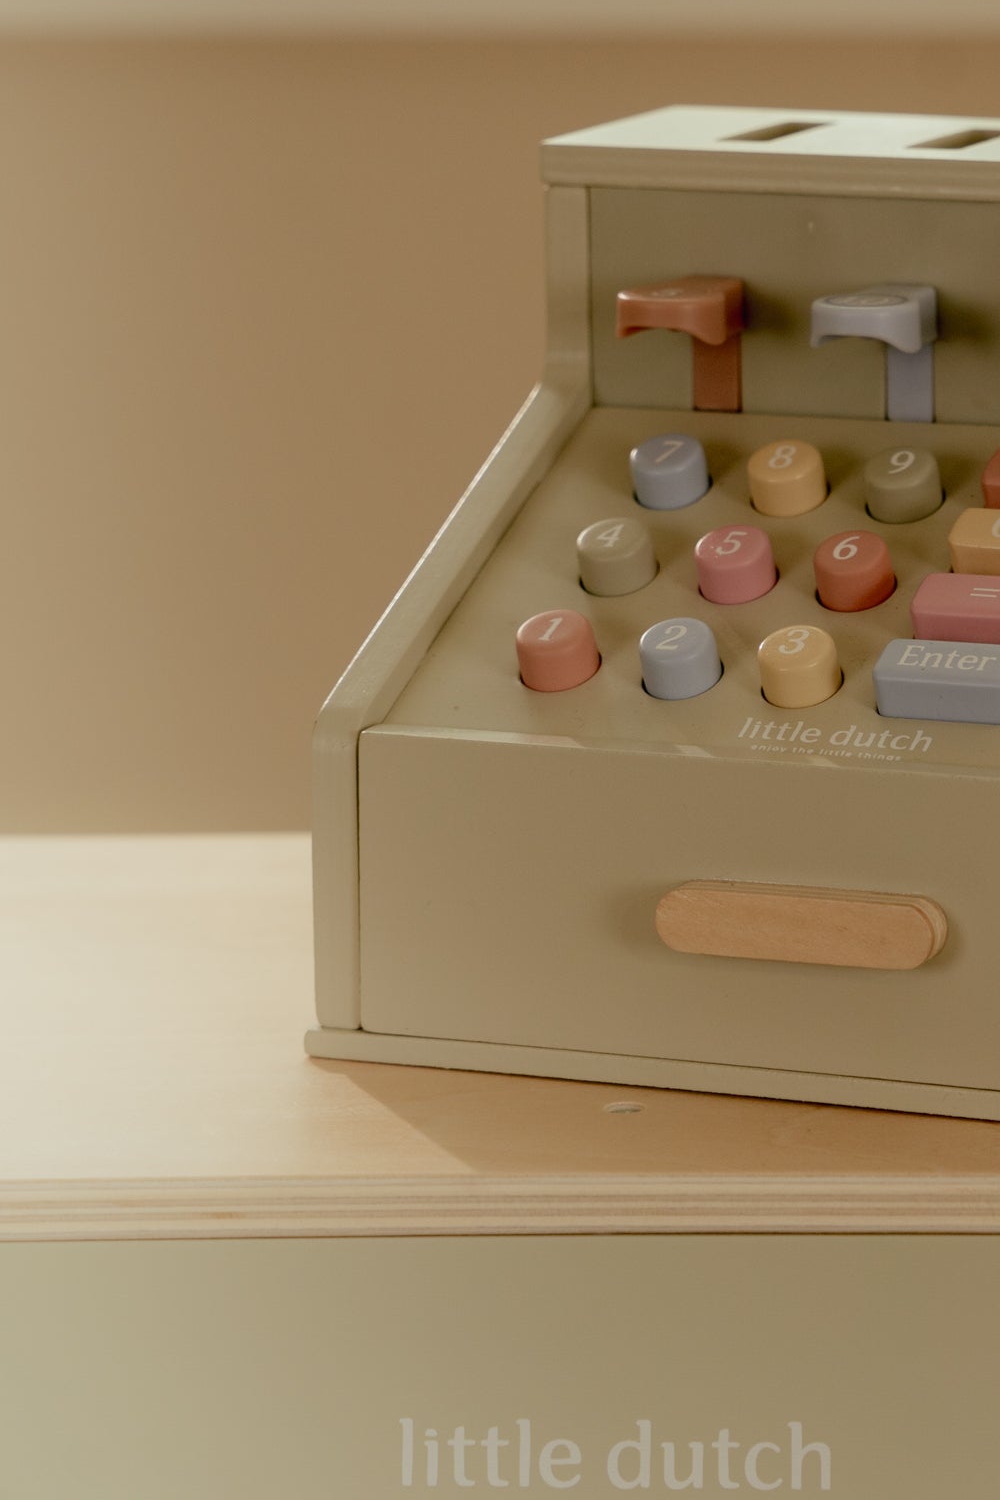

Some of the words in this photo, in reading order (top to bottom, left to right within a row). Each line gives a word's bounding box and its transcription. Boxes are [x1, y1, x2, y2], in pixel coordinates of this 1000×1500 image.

[654, 440, 682, 464] 7
[767, 444, 797, 469] 8
[888, 450, 915, 475] 9
[596, 523, 626, 549] 4
[715, 530, 748, 556] 5
[832, 535, 861, 561] 6
[537, 617, 564, 642] 1
[655, 624, 688, 651] 2
[777, 628, 811, 655] 3
[896, 643, 997, 673] Enter
[737, 716, 822, 744] little
[829, 723, 934, 753] dutch
[750, 743, 788, 753] enjoy
[792, 746, 813, 755] the
[819, 747, 853, 758] little
[858, 750, 902, 762] things
[399, 1417, 582, 1489] little
[606, 1418, 832, 1491] dutch
